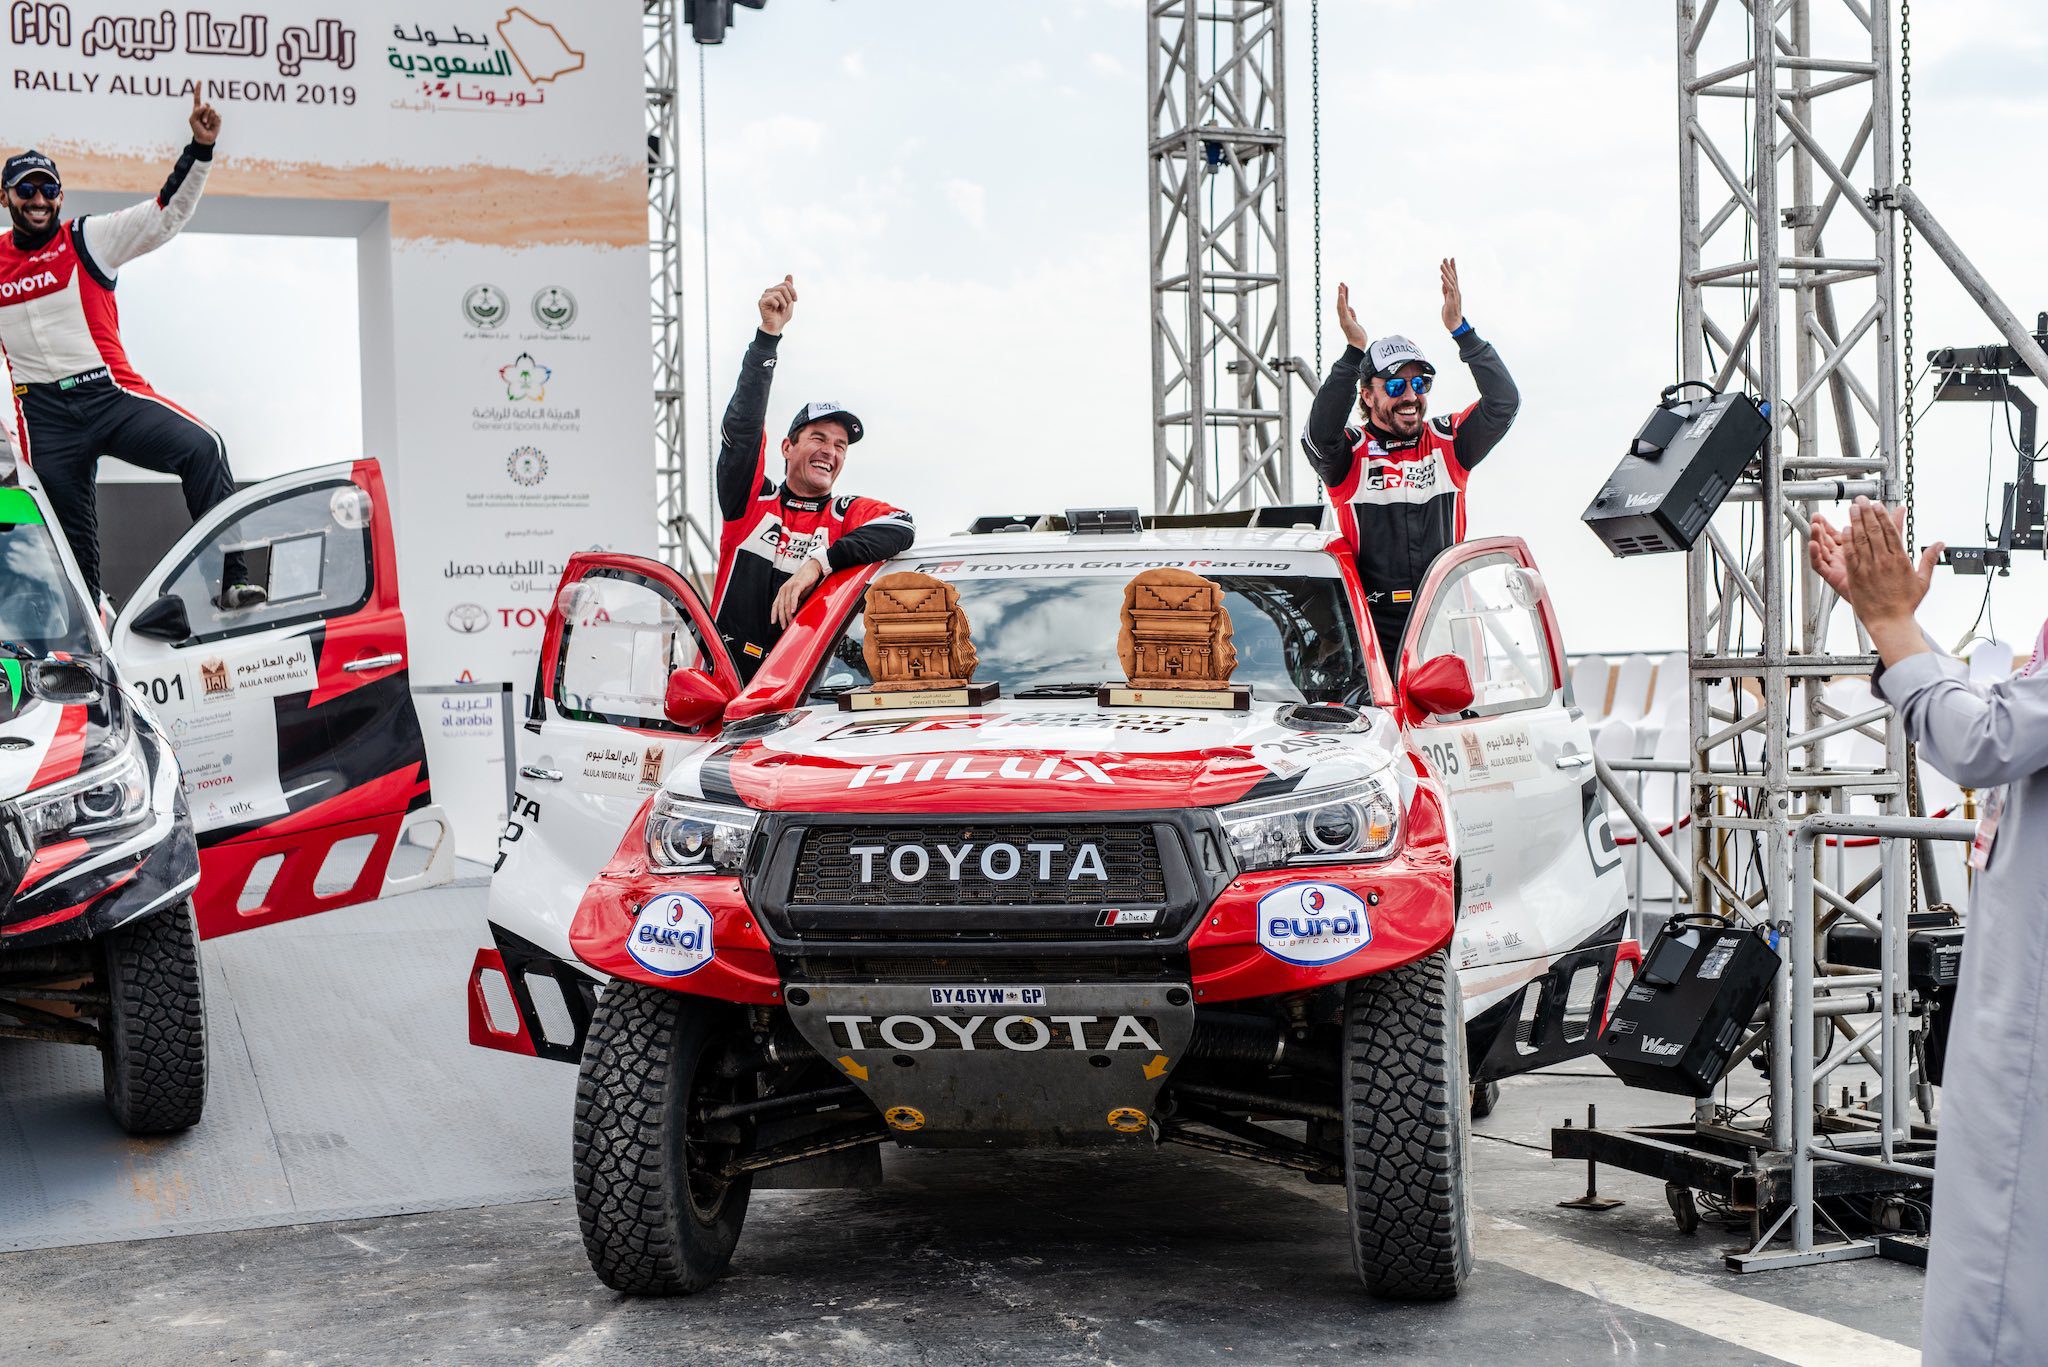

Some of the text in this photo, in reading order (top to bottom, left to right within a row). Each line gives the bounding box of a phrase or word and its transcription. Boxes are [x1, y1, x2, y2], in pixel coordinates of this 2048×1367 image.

[82, 11, 176, 60] نيوم
[186, 12, 267, 56] العلا
[393, 23, 489, 50] بطولة
[277, 19, 355, 76] رالي
[388, 48, 512, 78] السعودية
[14, 70, 356, 106] RALLY ALULA NEOM 2019
[457, 82, 545, 106] تويوتا
[0, 270, 58, 298] OYOTA
[1367, 466, 1403, 491] GR
[444, 560, 485, 579] جميل
[489, 560, 544, 576] اللطيف
[967, 563, 1074, 572] TOYOTA
[1080, 560, 1184, 569] GAZOO
[1188, 560, 1292, 571] Racing
[497, 608, 611, 627] TOYA
[239, 669, 309, 689] ALULA NEOM RALLY
[1261, 735, 1341, 754] 205
[621, 752, 639, 768] رالي
[197, 776, 233, 790] TOYOTA
[583, 768, 635, 782] ALULA NEOM RALLY
[846, 756, 1127, 789] HILUX
[229, 801, 254, 814] mbc
[850, 843, 1108, 884] TOYOTA
[1468, 901, 1493, 915] TOYOTA
[1268, 908, 1361, 939] eurol
[638, 924, 705, 951] eurol
[1268, 937, 1361, 947] LUBRICANTS
[634, 945, 704, 960] LUBRICANTS
[932, 988, 1042, 1004] BY46YW GP
[825, 1015, 1162, 1051] TOYOTA
